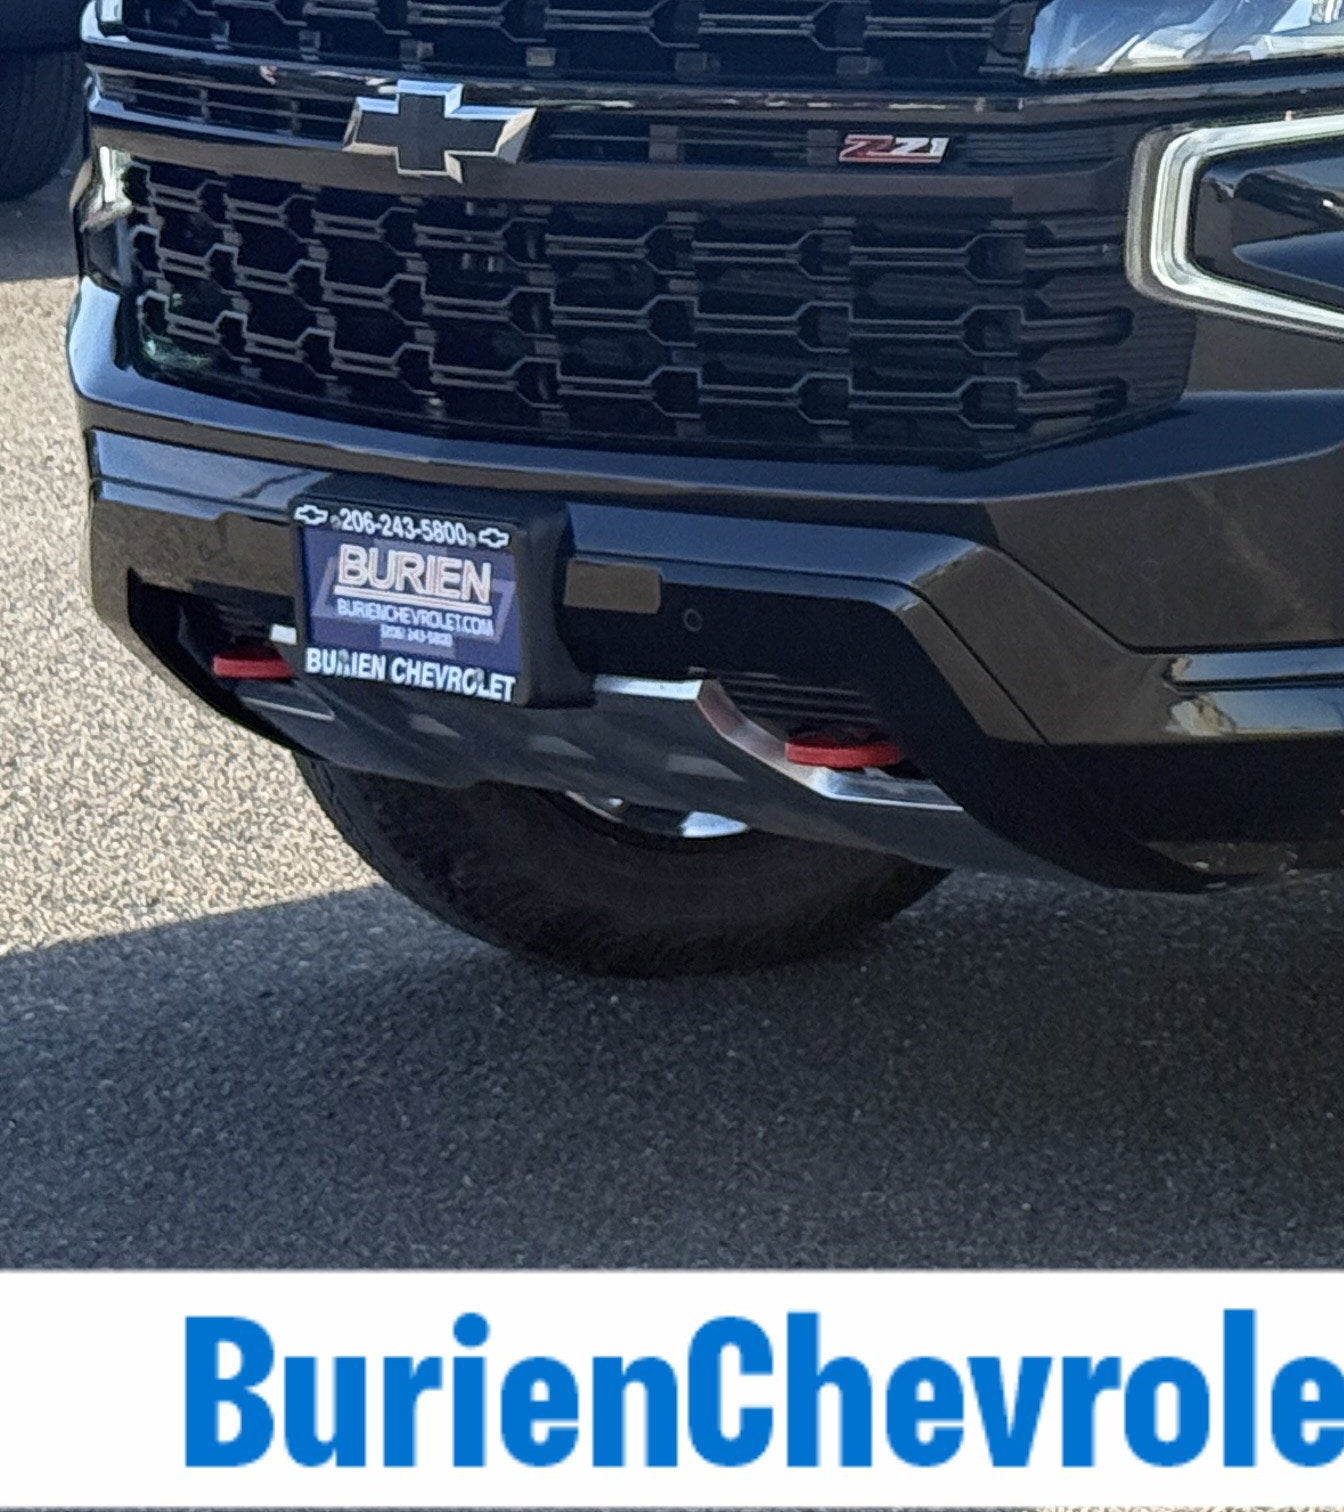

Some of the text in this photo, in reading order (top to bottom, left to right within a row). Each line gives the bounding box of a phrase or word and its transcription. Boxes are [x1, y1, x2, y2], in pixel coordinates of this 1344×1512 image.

[838, 134, 950, 163] Z71
[339, 507, 468, 546] 206-243-5800
[338, 543, 492, 604] BURIEN
[337, 598, 495, 637] BURIENCHEVROLET.COM
[391, 657, 516, 703] CHEVROLET
